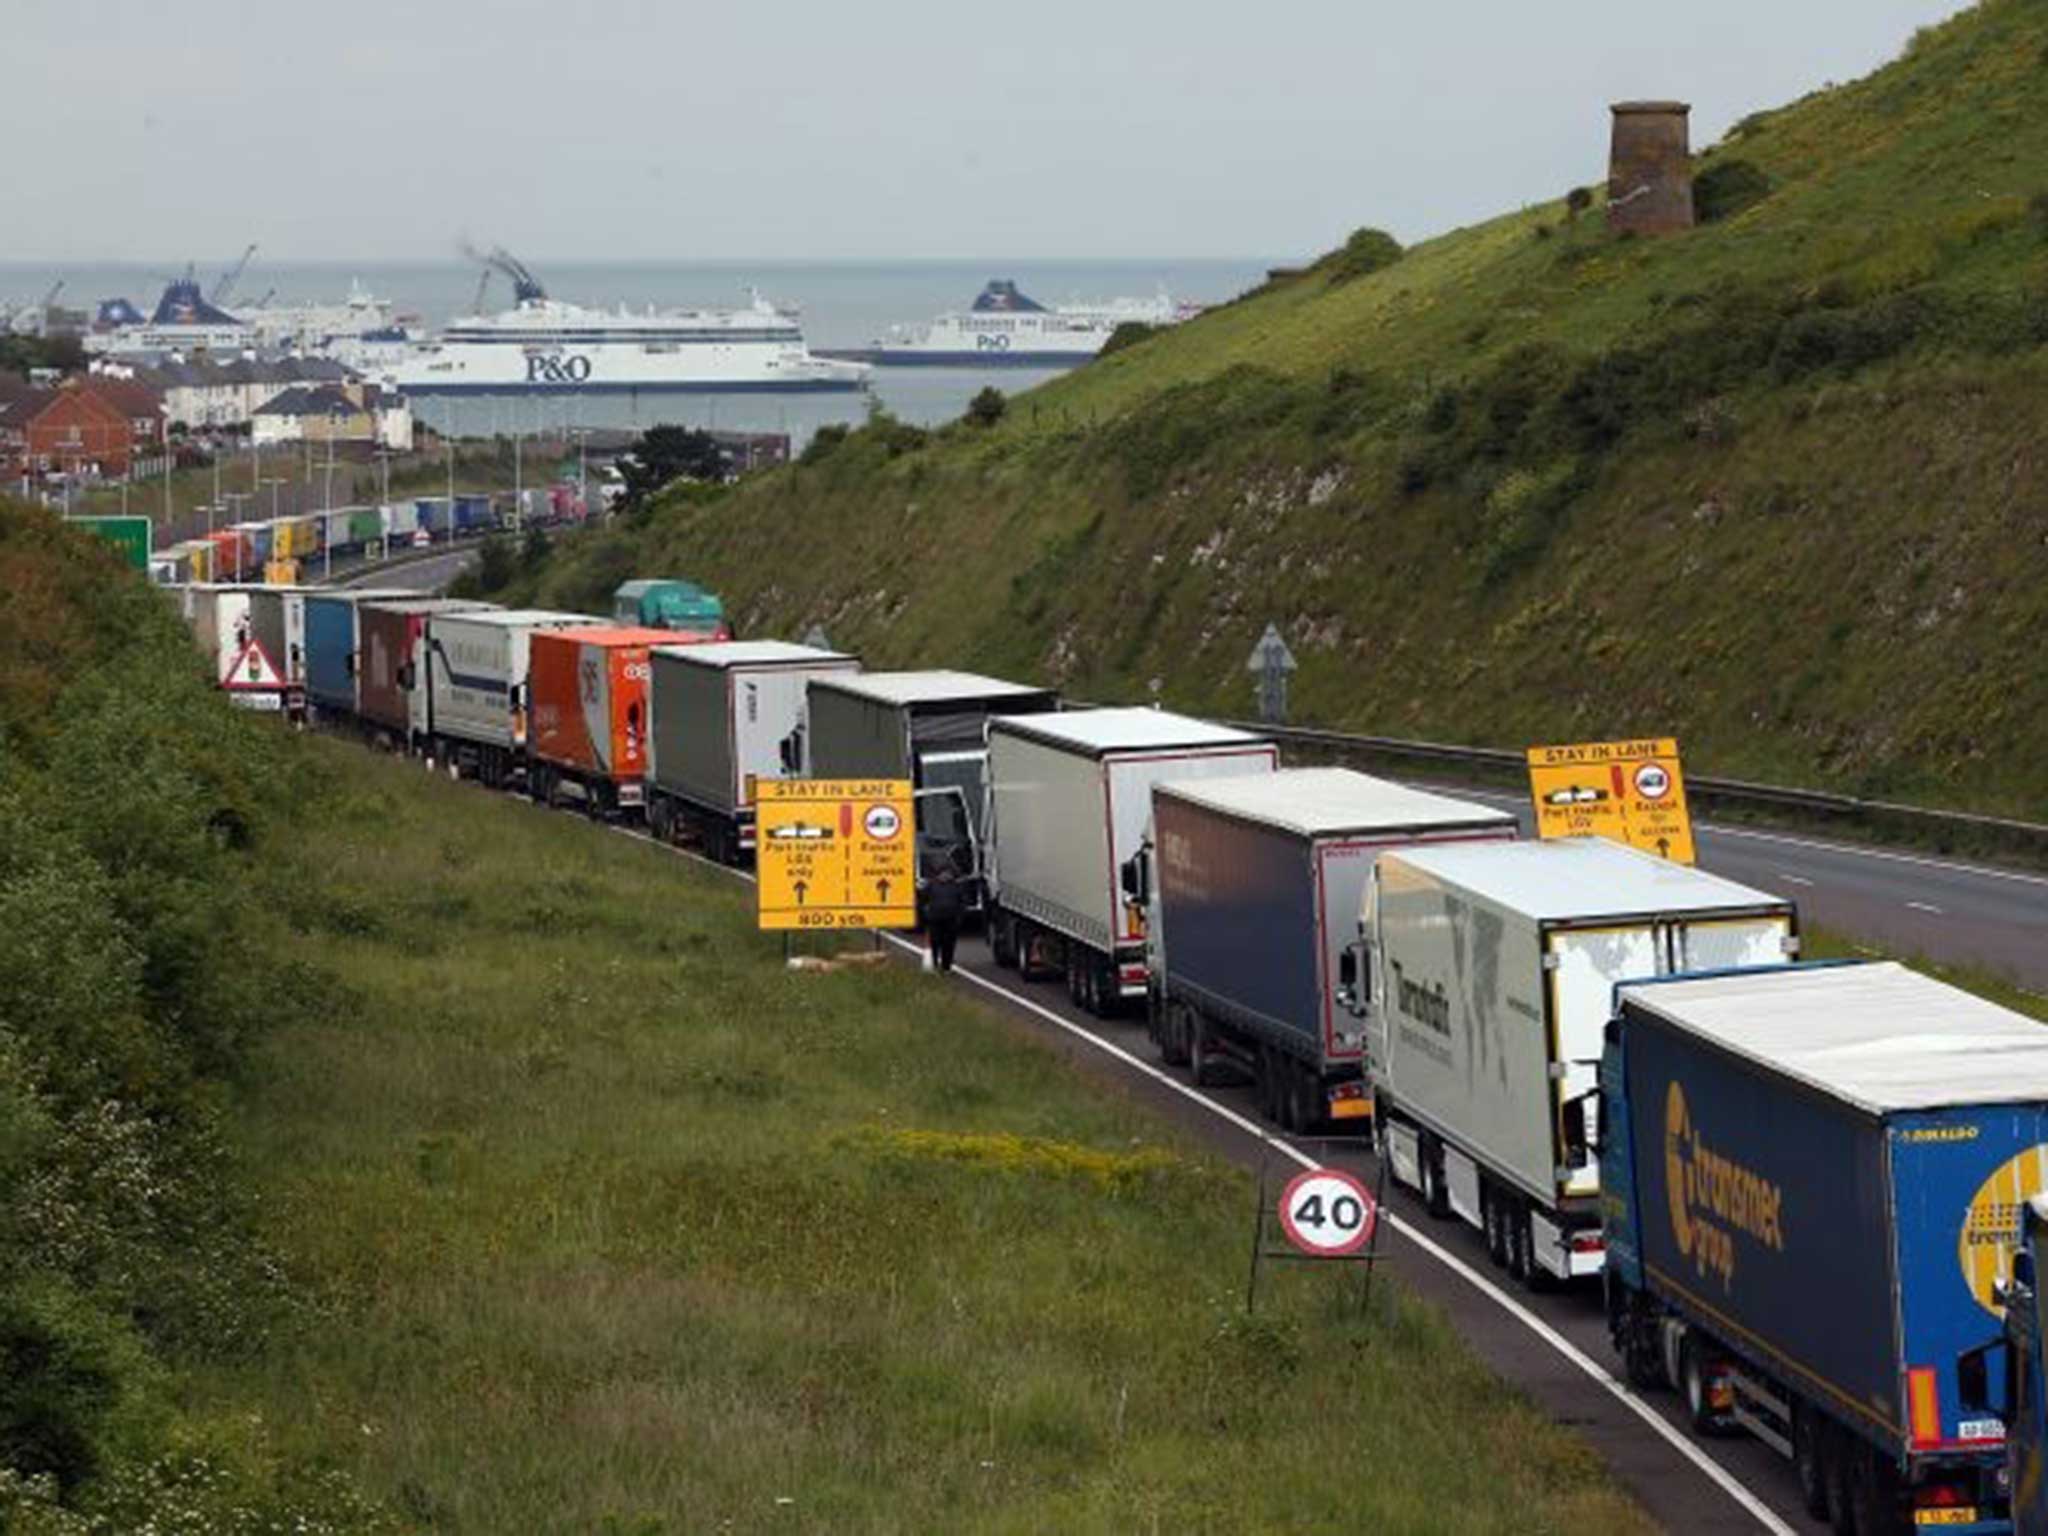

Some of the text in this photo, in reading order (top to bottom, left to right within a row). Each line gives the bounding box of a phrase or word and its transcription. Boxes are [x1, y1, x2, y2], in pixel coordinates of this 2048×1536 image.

[527, 355, 591, 382] P&O
[1546, 743, 1658, 762] STAY IN LANE
[775, 782, 895, 796] STAY IN LANE
[1295, 1194, 1362, 1230] 40
